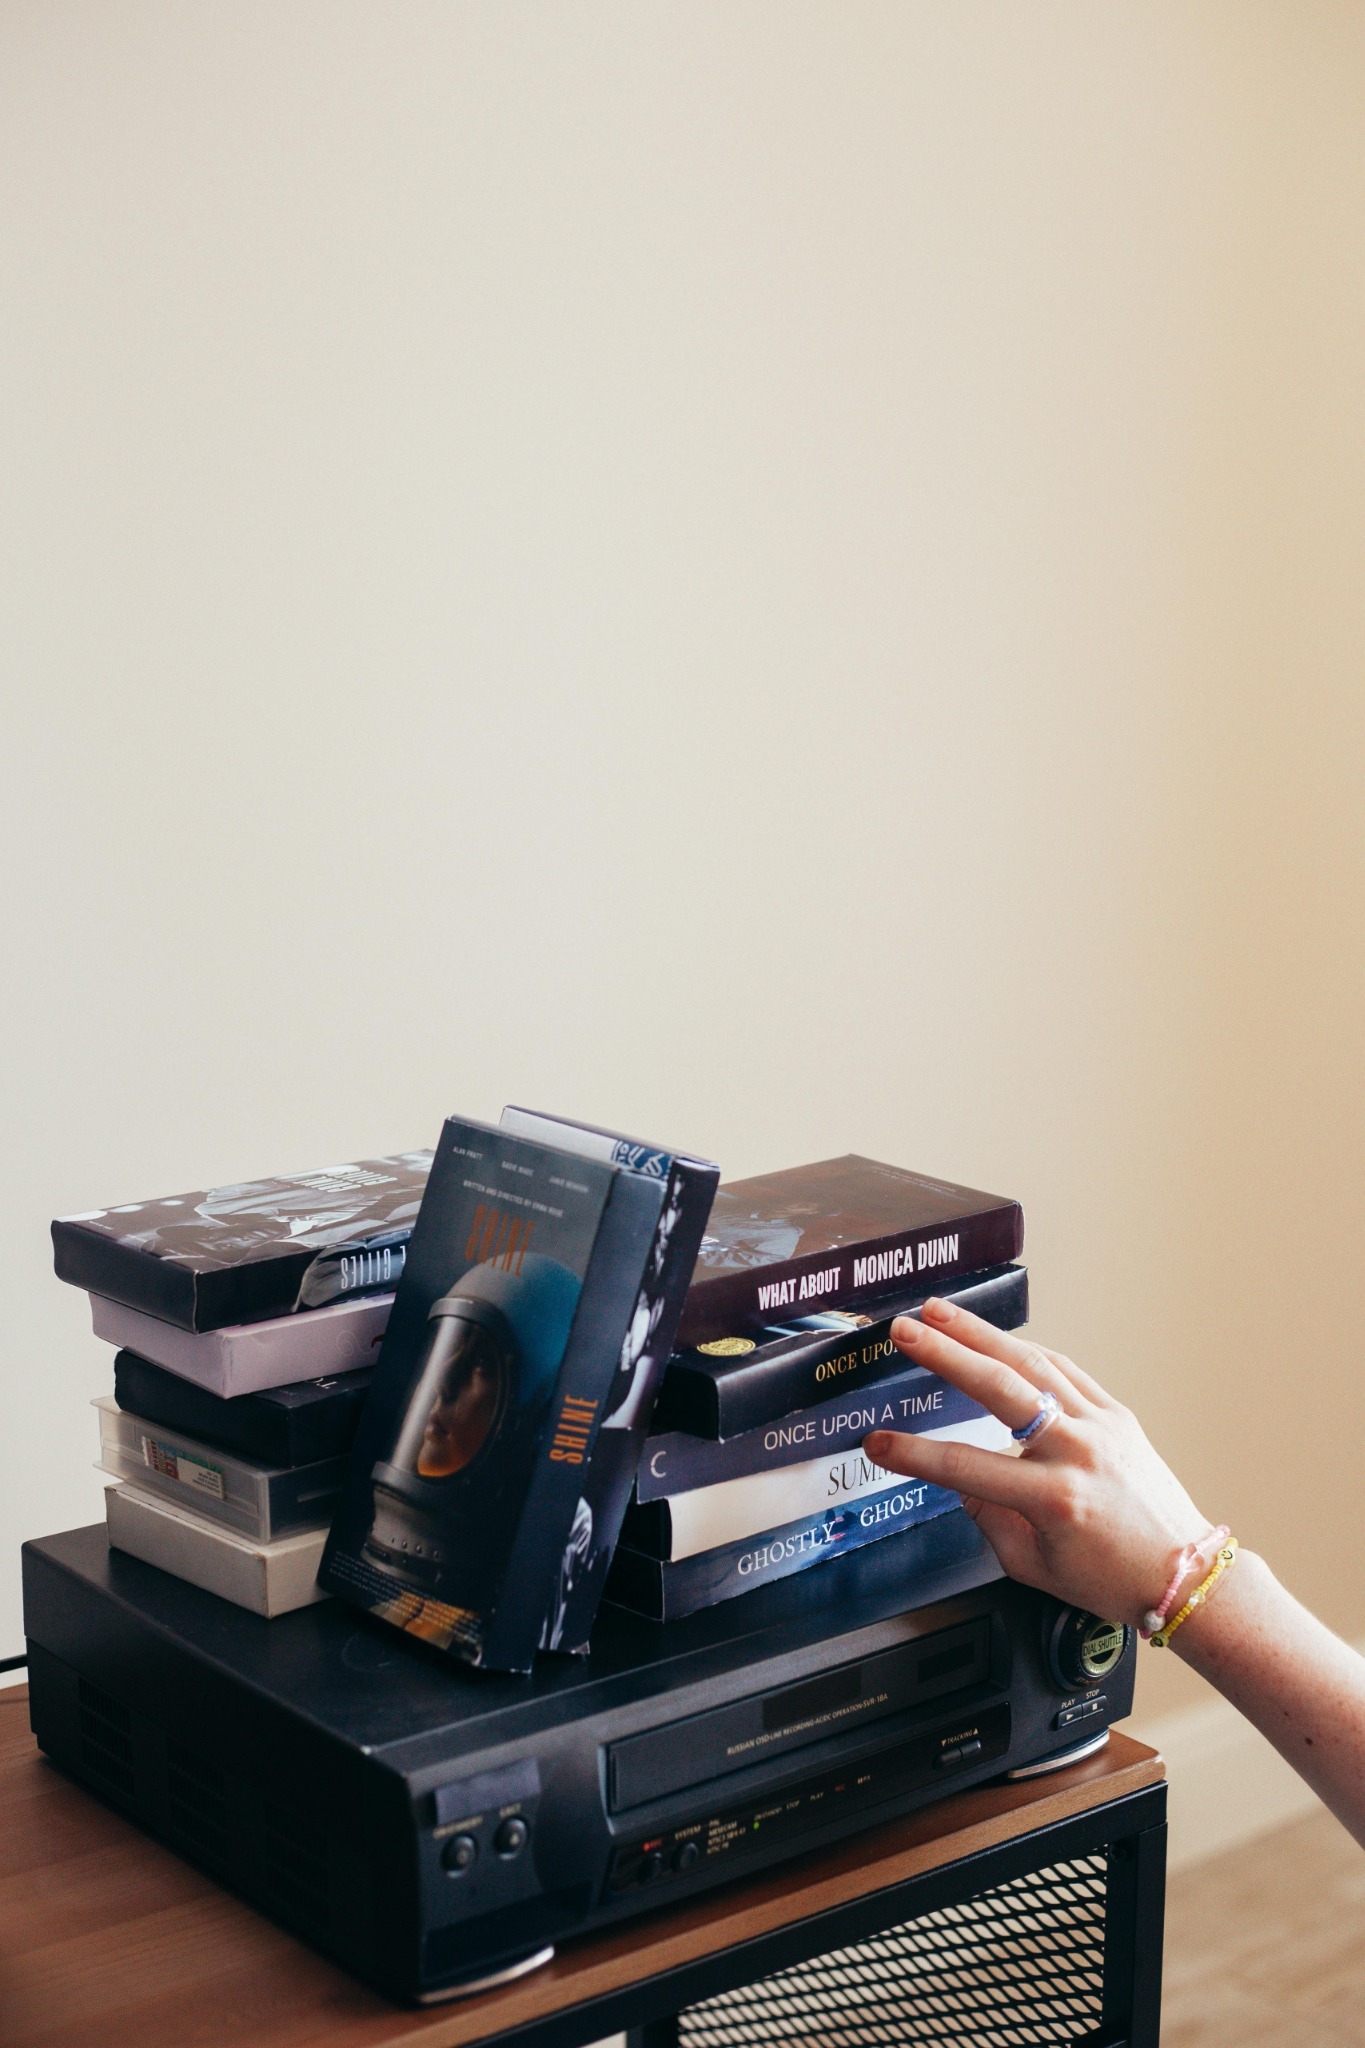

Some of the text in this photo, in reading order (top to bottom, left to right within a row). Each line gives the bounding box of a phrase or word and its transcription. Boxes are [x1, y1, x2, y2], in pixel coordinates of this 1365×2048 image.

[464, 1205, 536, 1277] SHINE
[340, 1248, 391, 1290] CITIES
[758, 1233, 959, 1311] WHAT ABOUT MONICA DUNN
[815, 1338, 898, 1382] ONCE UPO
[549, 1394, 599, 1465] SHINE
[764, 1391, 943, 1451] ONCE UPON A TIME
[738, 1484, 929, 1576] GHOSTLY GHOST
[1098, 1633, 1122, 1652] SHUTTLE
[1061, 1688, 1100, 1709] PLAY STOP
[947, 1730, 973, 1744] TRACKING
[786, 1800, 800, 1810] STOP
[810, 1792, 824, 1801] PLAY
[675, 1825, 701, 1840] SYSTEM
